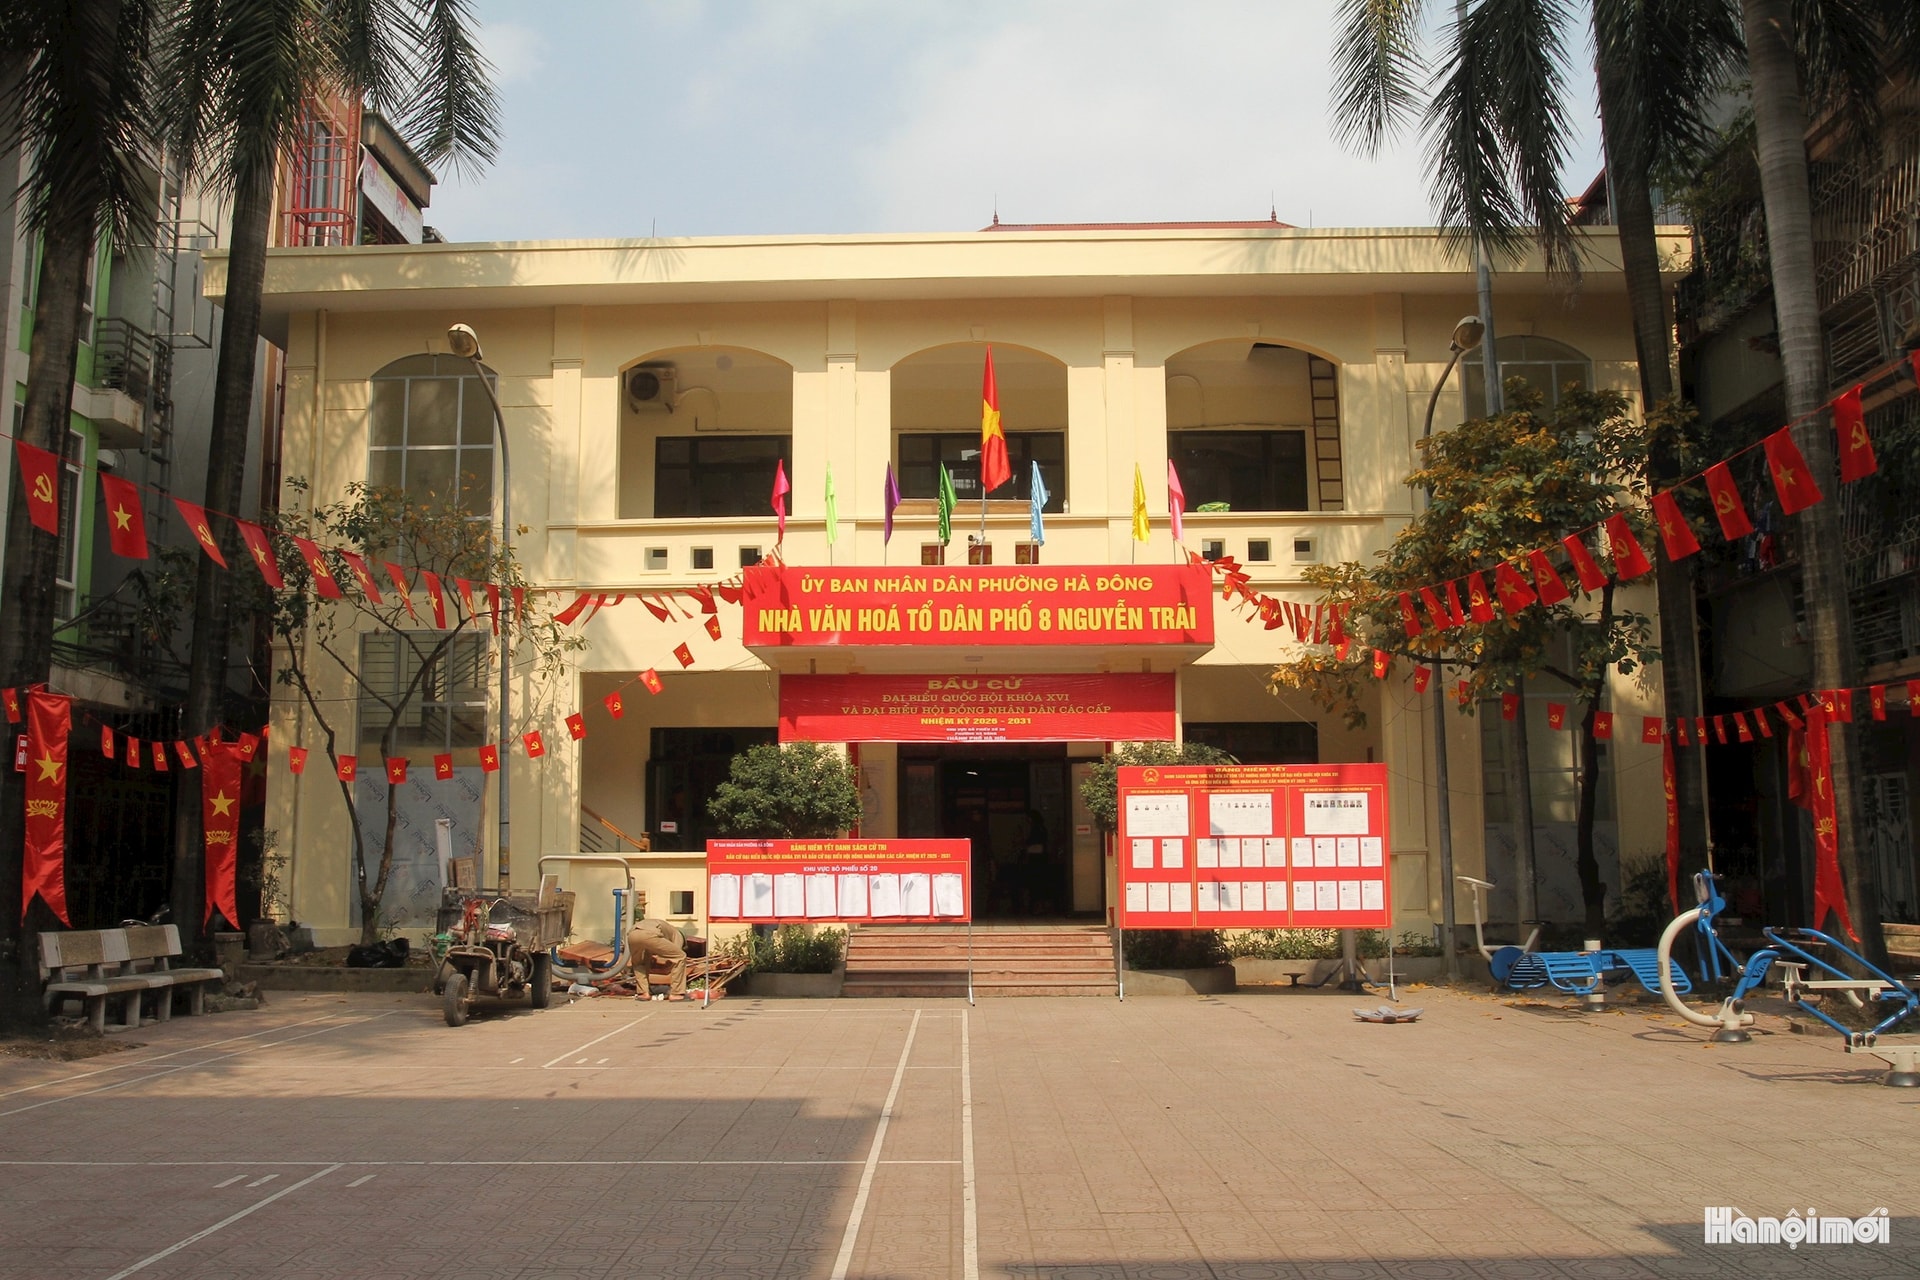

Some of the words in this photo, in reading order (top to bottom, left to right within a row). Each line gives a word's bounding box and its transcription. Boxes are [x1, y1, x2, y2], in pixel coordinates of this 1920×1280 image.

[801, 574, 824, 592] ỦY
[830, 578, 868, 592] BAN
[874, 575, 927, 592] NHÂN
[933, 575, 972, 592] DÂN
[979, 574, 1058, 592] PHƯỜNG
[1064, 574, 1090, 591] HÀ
[1096, 574, 1153, 591] ĐÔNG
[759, 605, 802, 632] NHÀ
[809, 604, 851, 631] VĂN
[858, 604, 900, 631] HOÁ
[907, 600, 933, 631] TỔ
[940, 605, 982, 631] DÂN
[990, 600, 1032, 631] PHỐ
[1039, 608, 1051, 631] 8
[1058, 599, 1143, 630] NGUYỄN
[1149, 602, 1196, 629] TRÃI
[928, 676, 978, 689] BẦU
[987, 676, 1022, 689] CỬ
[883, 694, 905, 703] ĐẠI
[909, 690, 938, 701] BIỂU
[942, 692, 976, 702] QUỐC
[980, 692, 1003, 703] HỘI
[1007, 692, 1042, 701] KHÓA
[842, 705, 858, 714] VÀ
[863, 707, 884, 716] ĐẠI
[889, 703, 918, 714] BIỂU
[922, 705, 944, 715] HỘI
[949, 704, 984, 714] ĐỒNG
[989, 705, 1025, 714] NHÂN
[1029, 705, 1056, 714] DÂN
[1060, 704, 1083, 714] CÁC
[1087, 703, 1111, 714] CẤP
